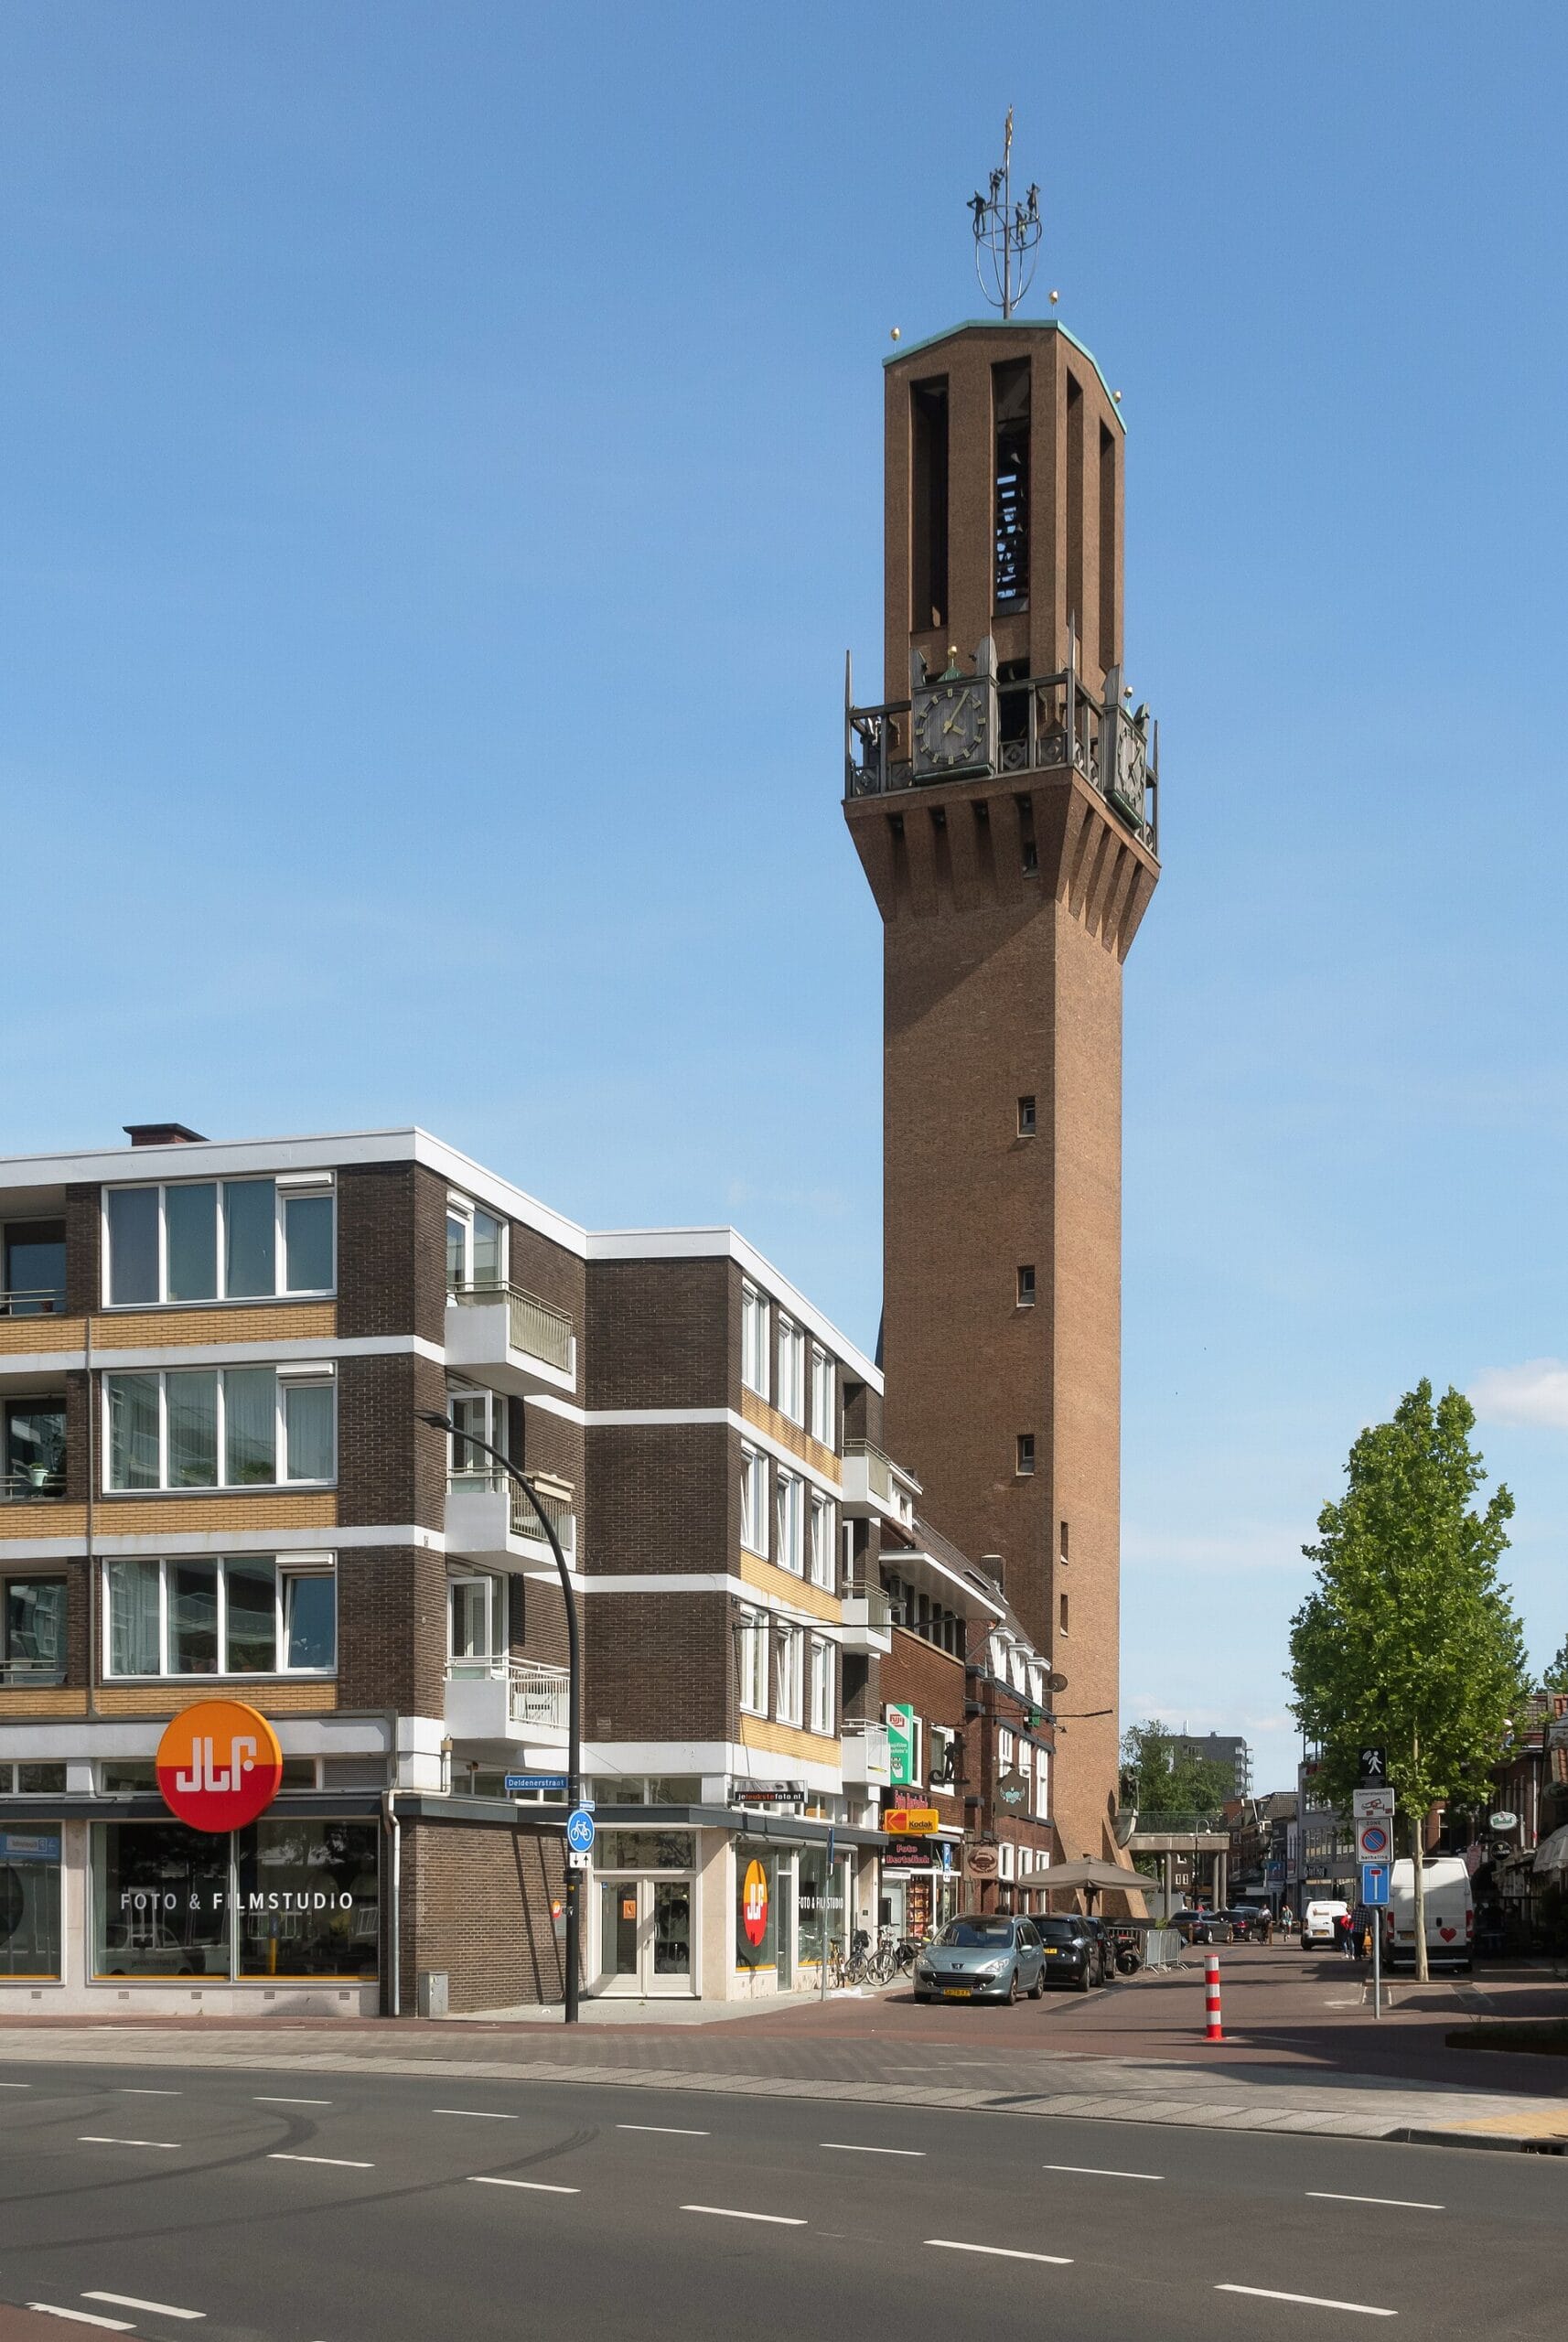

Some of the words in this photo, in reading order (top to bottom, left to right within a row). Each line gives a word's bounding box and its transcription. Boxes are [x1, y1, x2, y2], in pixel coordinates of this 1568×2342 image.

[737, 1793, 801, 1801] jeleukstefoto.nl
[908, 1820, 933, 1828] Kodak
[897, 1844, 918, 1853] Foto
[121, 1893, 177, 1910] FOTO
[189, 1893, 201, 1910] &
[213, 1892, 353, 1909] FILMSTUDIO
[798, 1896, 811, 1909] FOTO
[811, 1897, 815, 1909] &
